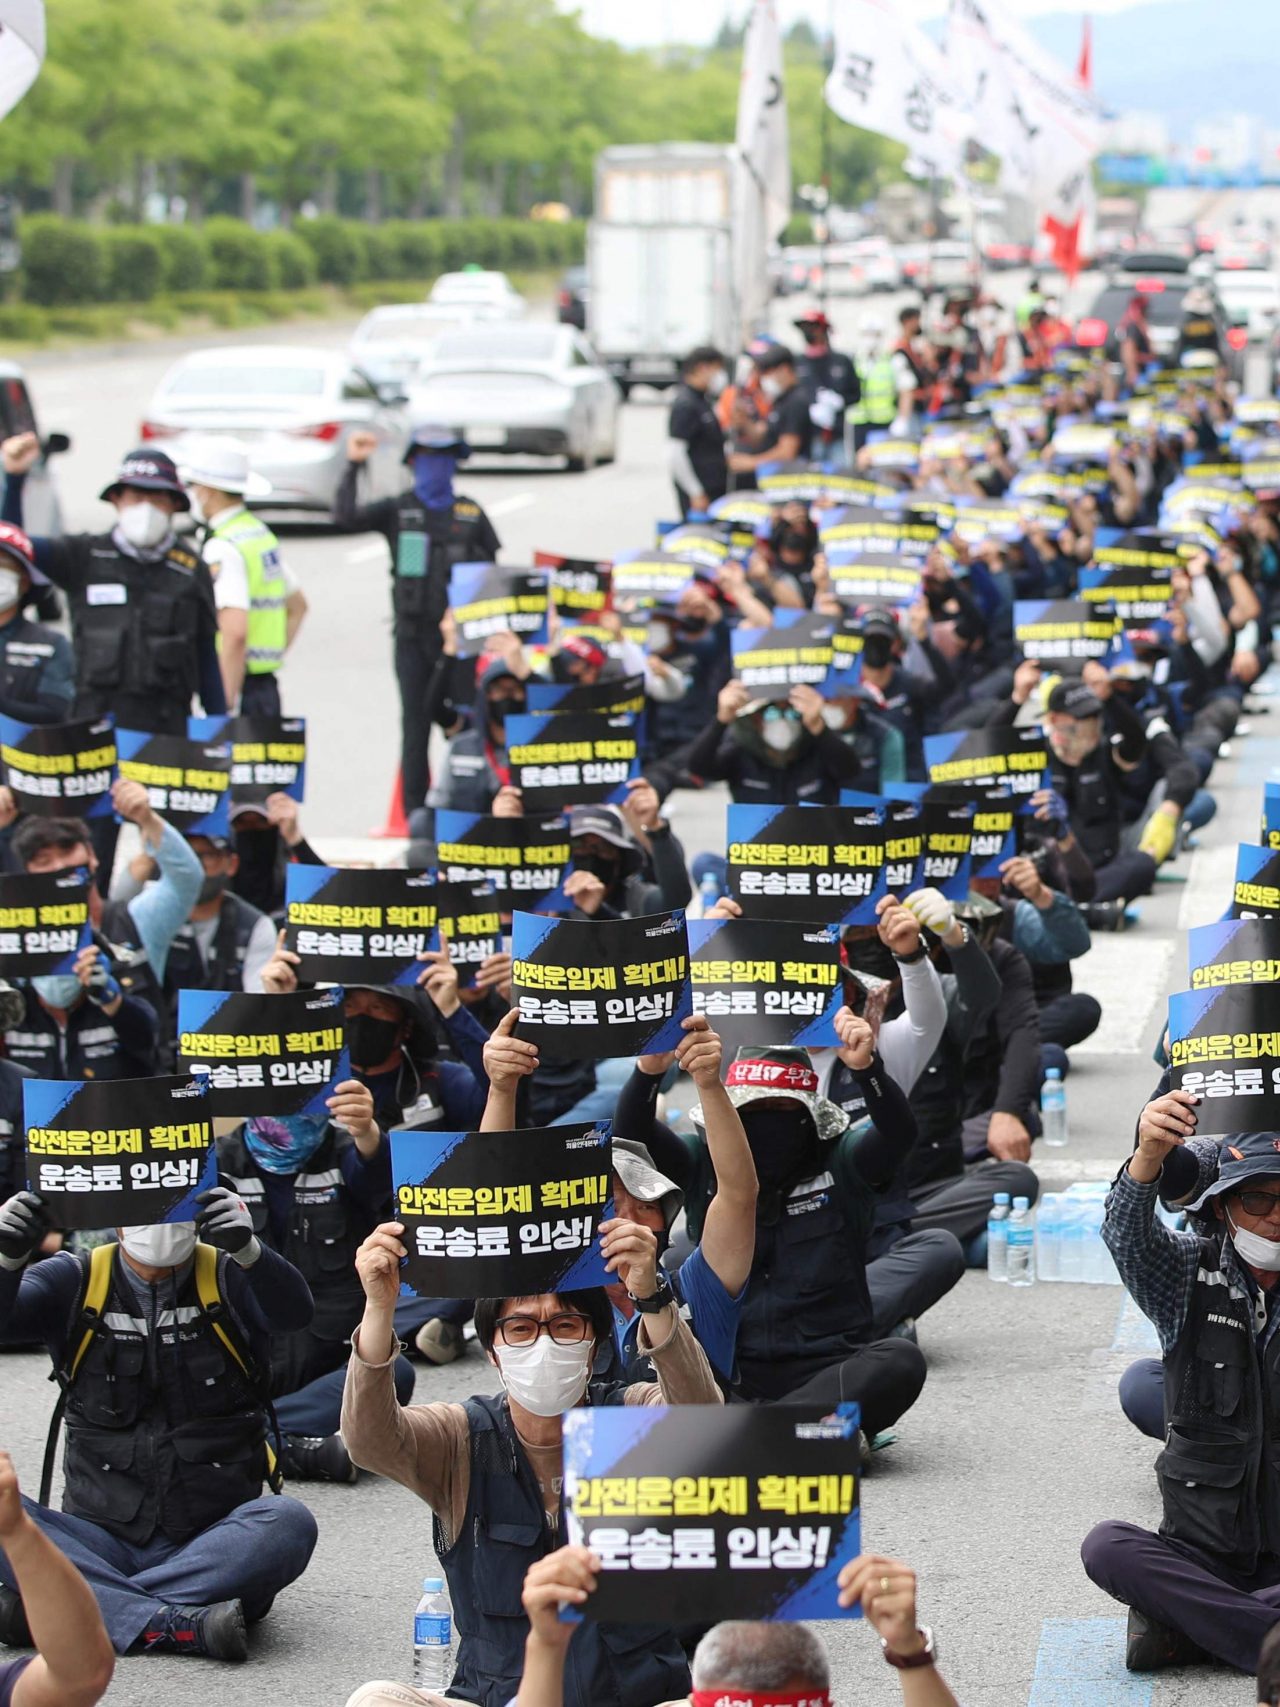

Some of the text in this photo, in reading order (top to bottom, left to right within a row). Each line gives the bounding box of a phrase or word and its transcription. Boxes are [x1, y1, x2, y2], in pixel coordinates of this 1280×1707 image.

[438, 844, 569, 865] 안전운임제 확대!
[729, 844, 883, 866] 안전운임제 확대!
[929, 834, 970, 852] 확대!
[971, 836, 1002, 854] 상!
[510, 869, 559, 889] 인상!
[886, 864, 912, 885] 상!
[924, 858, 957, 876] 상!
[740, 871, 872, 895] 운송료 인상!
[42, 903, 87, 925] 확대!
[288, 904, 436, 927] 안전운임제 확대!
[457, 913, 500, 935] 확대!
[25, 930, 77, 953] 인상!
[296, 931, 424, 957] 운송료 인상!
[512, 956, 684, 990] 안전운임제 확대!
[691, 960, 837, 985] 전운임제 확대!
[518, 992, 673, 1024] 운송료 인상!
[764, 991, 824, 1015] 인상!
[180, 1028, 342, 1057] 안전운임제 확대!
[270, 1060, 331, 1085] 인상!
[735, 1064, 763, 1081] 단결
[1181, 1068, 1263, 1099] 운송료
[28, 1122, 208, 1155] 안전운임제 확대!
[40, 1159, 198, 1191] 운송료 인상!
[399, 1175, 607, 1215] 안전운임제 확대!
[416, 1216, 592, 1257] 운송료 인상!
[577, 1475, 853, 1517] 안전운임제 확대!
[589, 1527, 830, 1569] 운송료 인상!
